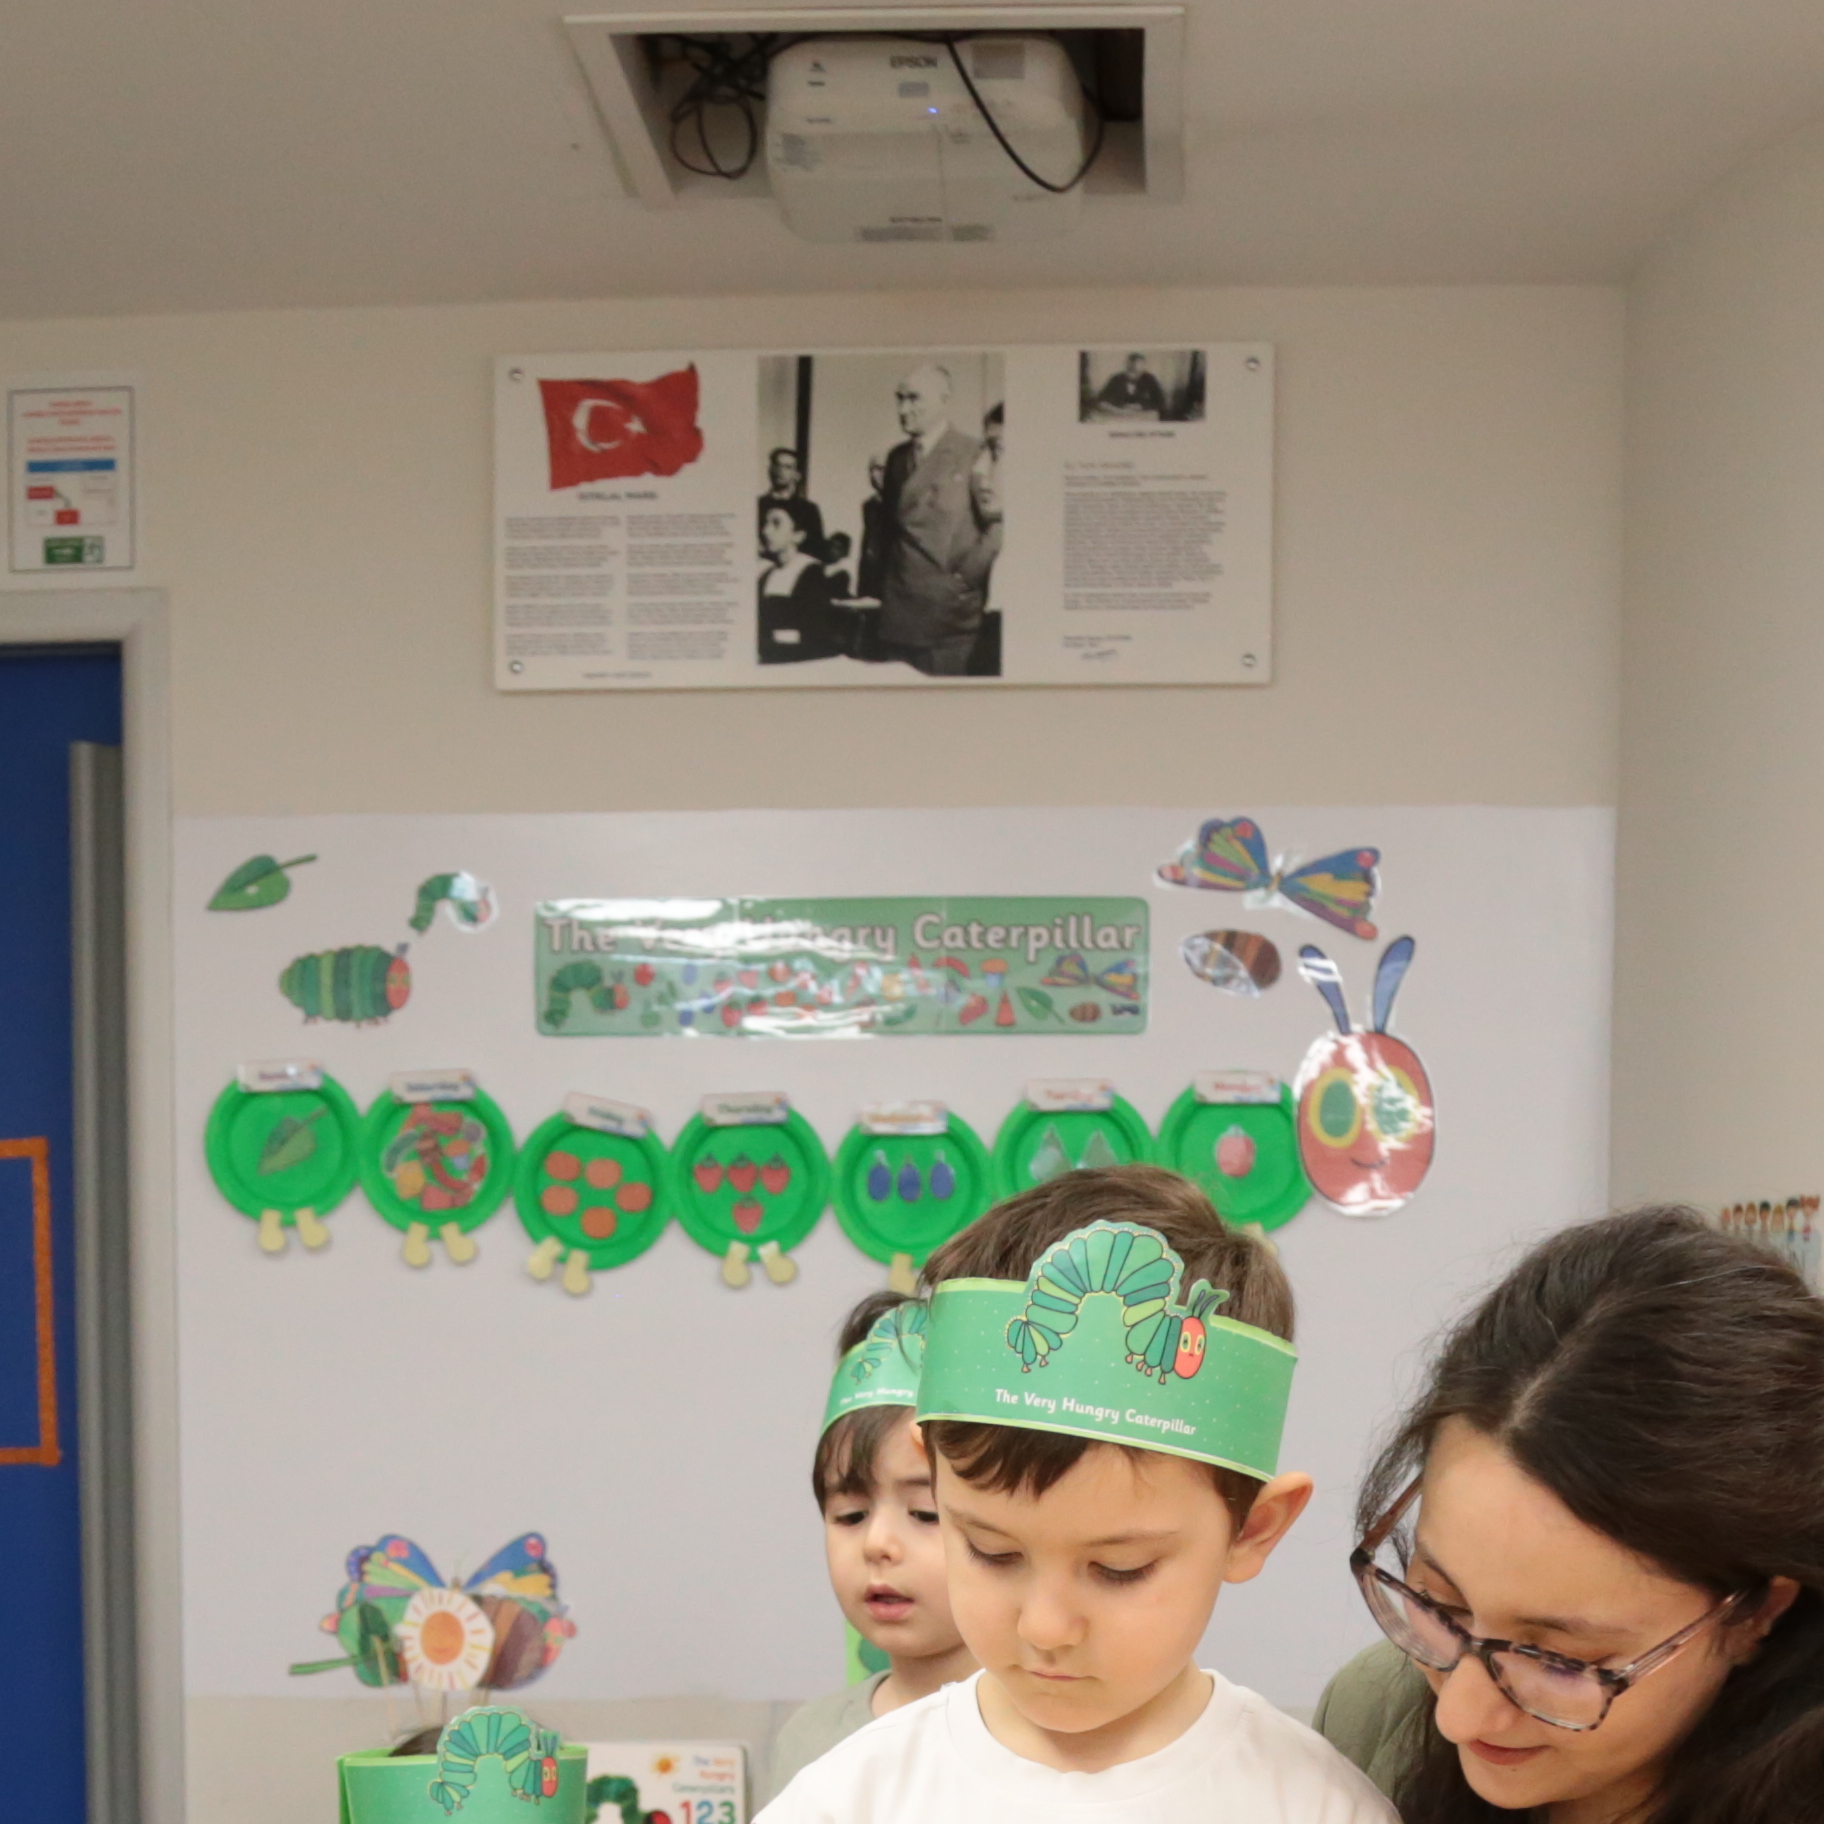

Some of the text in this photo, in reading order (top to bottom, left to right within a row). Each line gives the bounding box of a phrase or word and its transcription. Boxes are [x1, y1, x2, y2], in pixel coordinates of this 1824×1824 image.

[889, 55, 938, 69] EPSON
[542, 915, 616, 954] The
[911, 911, 1142, 963] Caterpillar
[995, 1388, 1197, 1436] The Very Hungry Caterpillar
